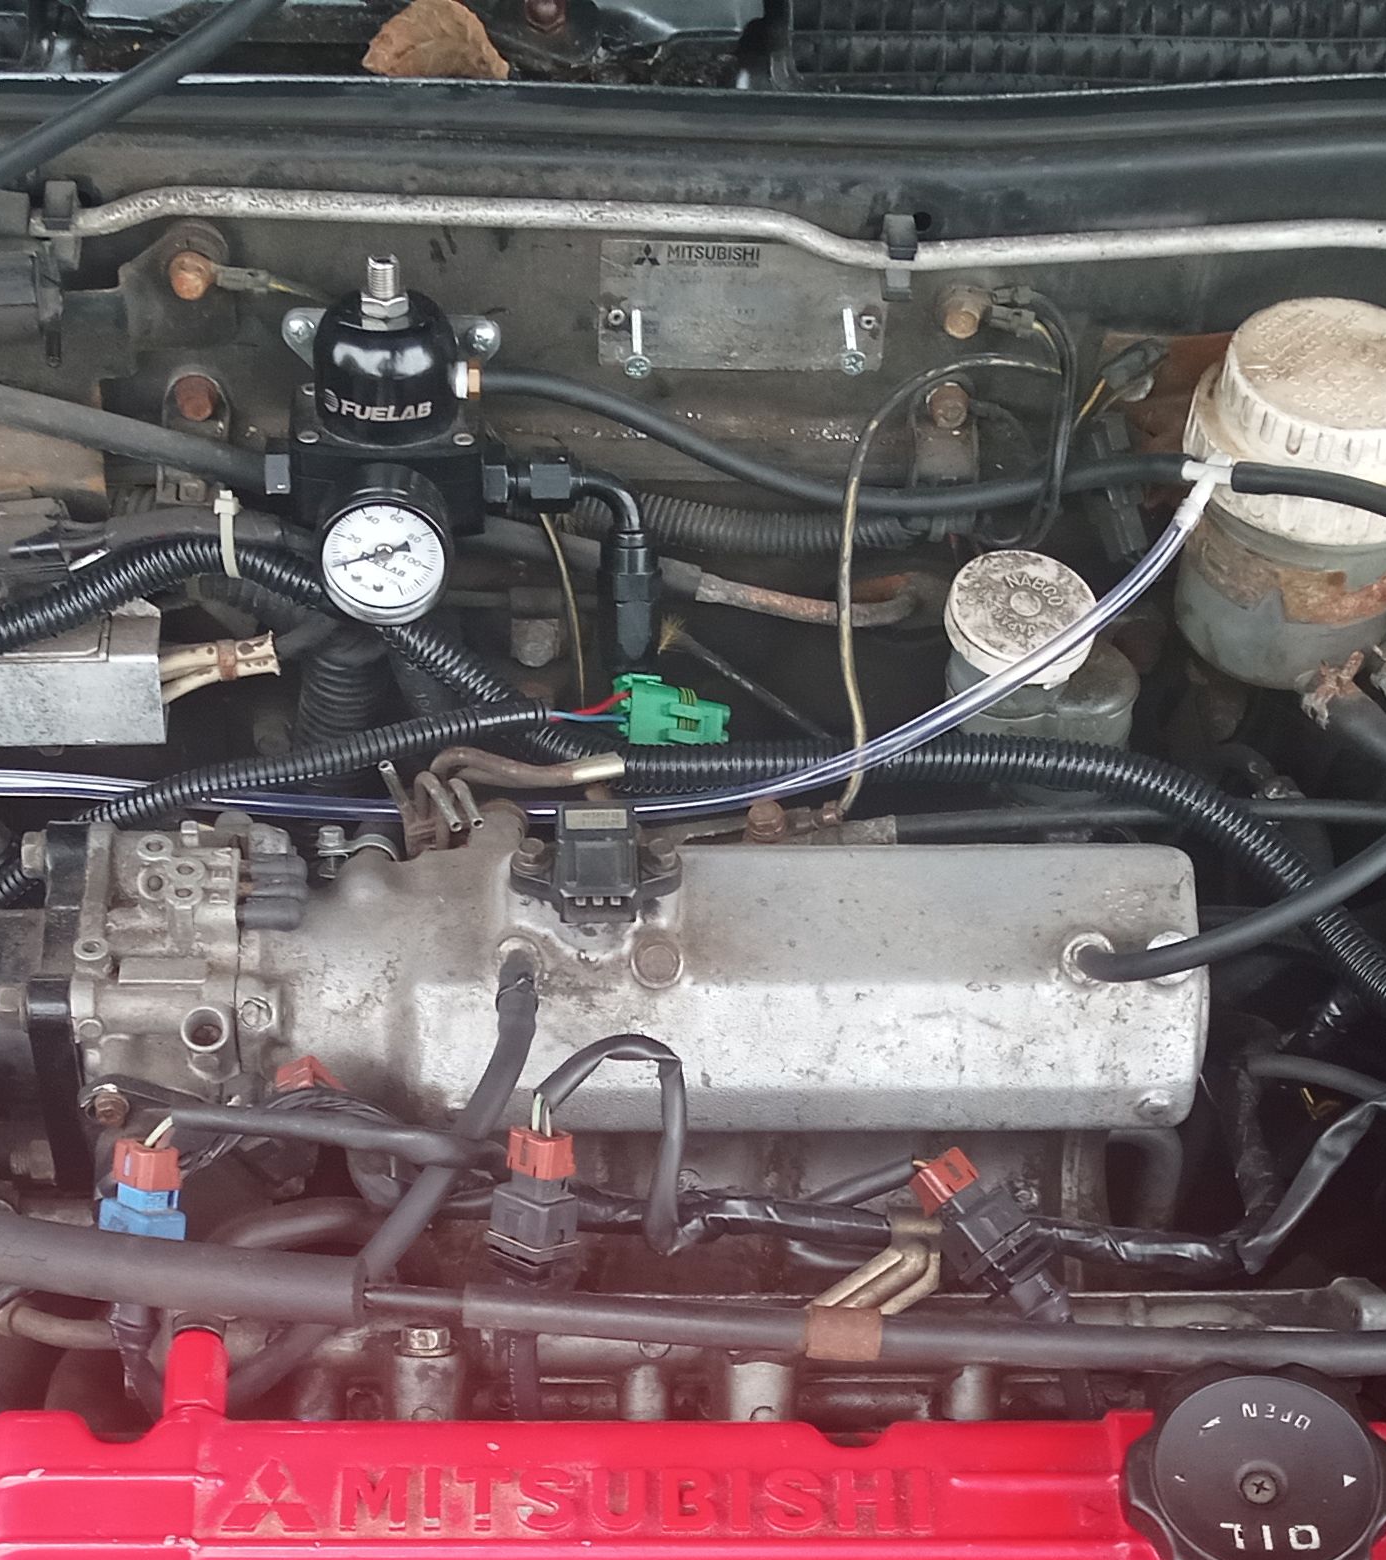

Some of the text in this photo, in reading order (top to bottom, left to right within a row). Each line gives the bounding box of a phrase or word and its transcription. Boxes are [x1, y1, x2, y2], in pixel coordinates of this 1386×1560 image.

[666, 244, 761, 262] MITSUBISHI
[340, 398, 433, 422] FUELAB
[389, 514, 404, 523] 60
[1003, 574, 1064, 607] NABCO
[337, 1463, 935, 1536] MITSUBISHI
[1219, 1521, 1321, 1551] OIL
